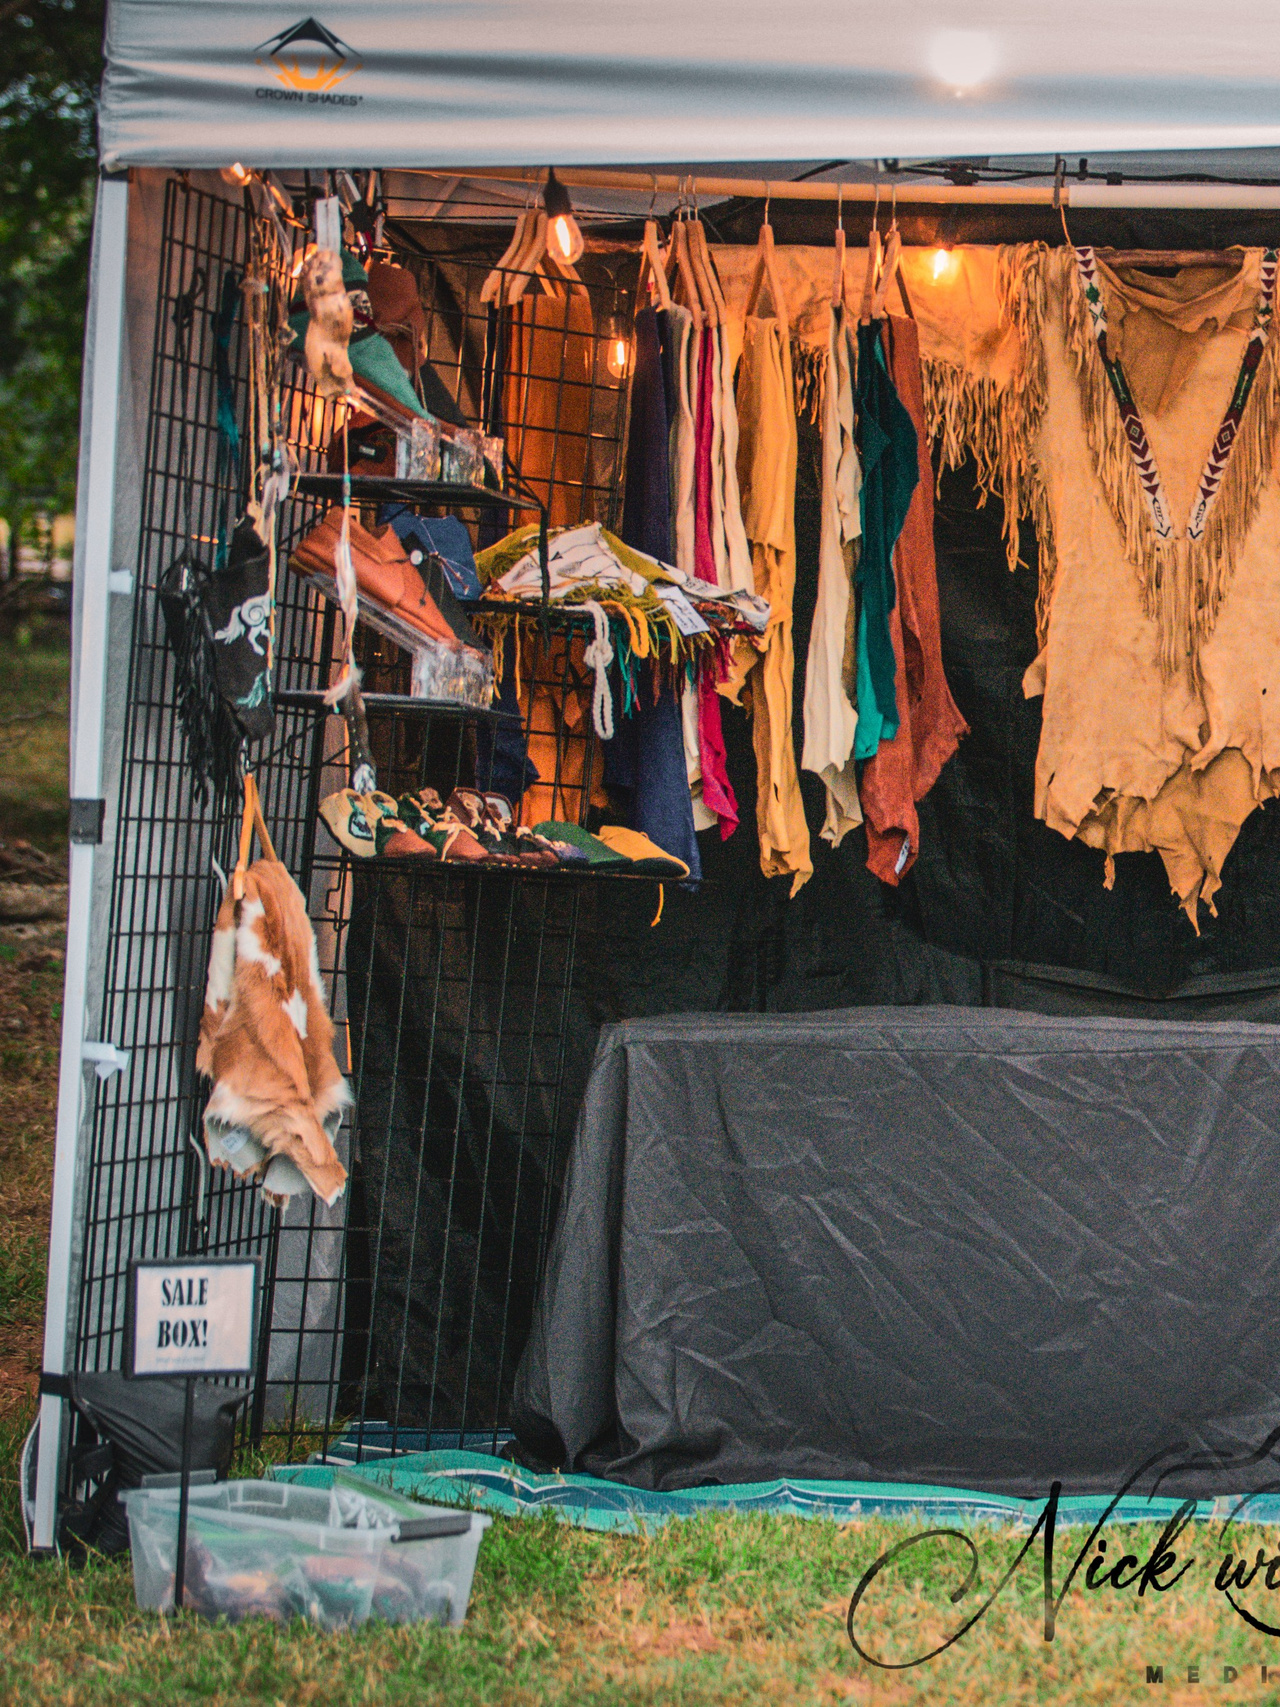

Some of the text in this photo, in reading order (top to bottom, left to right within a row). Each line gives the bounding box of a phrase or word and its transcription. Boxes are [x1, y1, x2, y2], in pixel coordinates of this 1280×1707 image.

[255, 88, 304, 102] CROWN
[161, 1278, 209, 1306] SALE
[157, 1318, 209, 1348] BOX!
